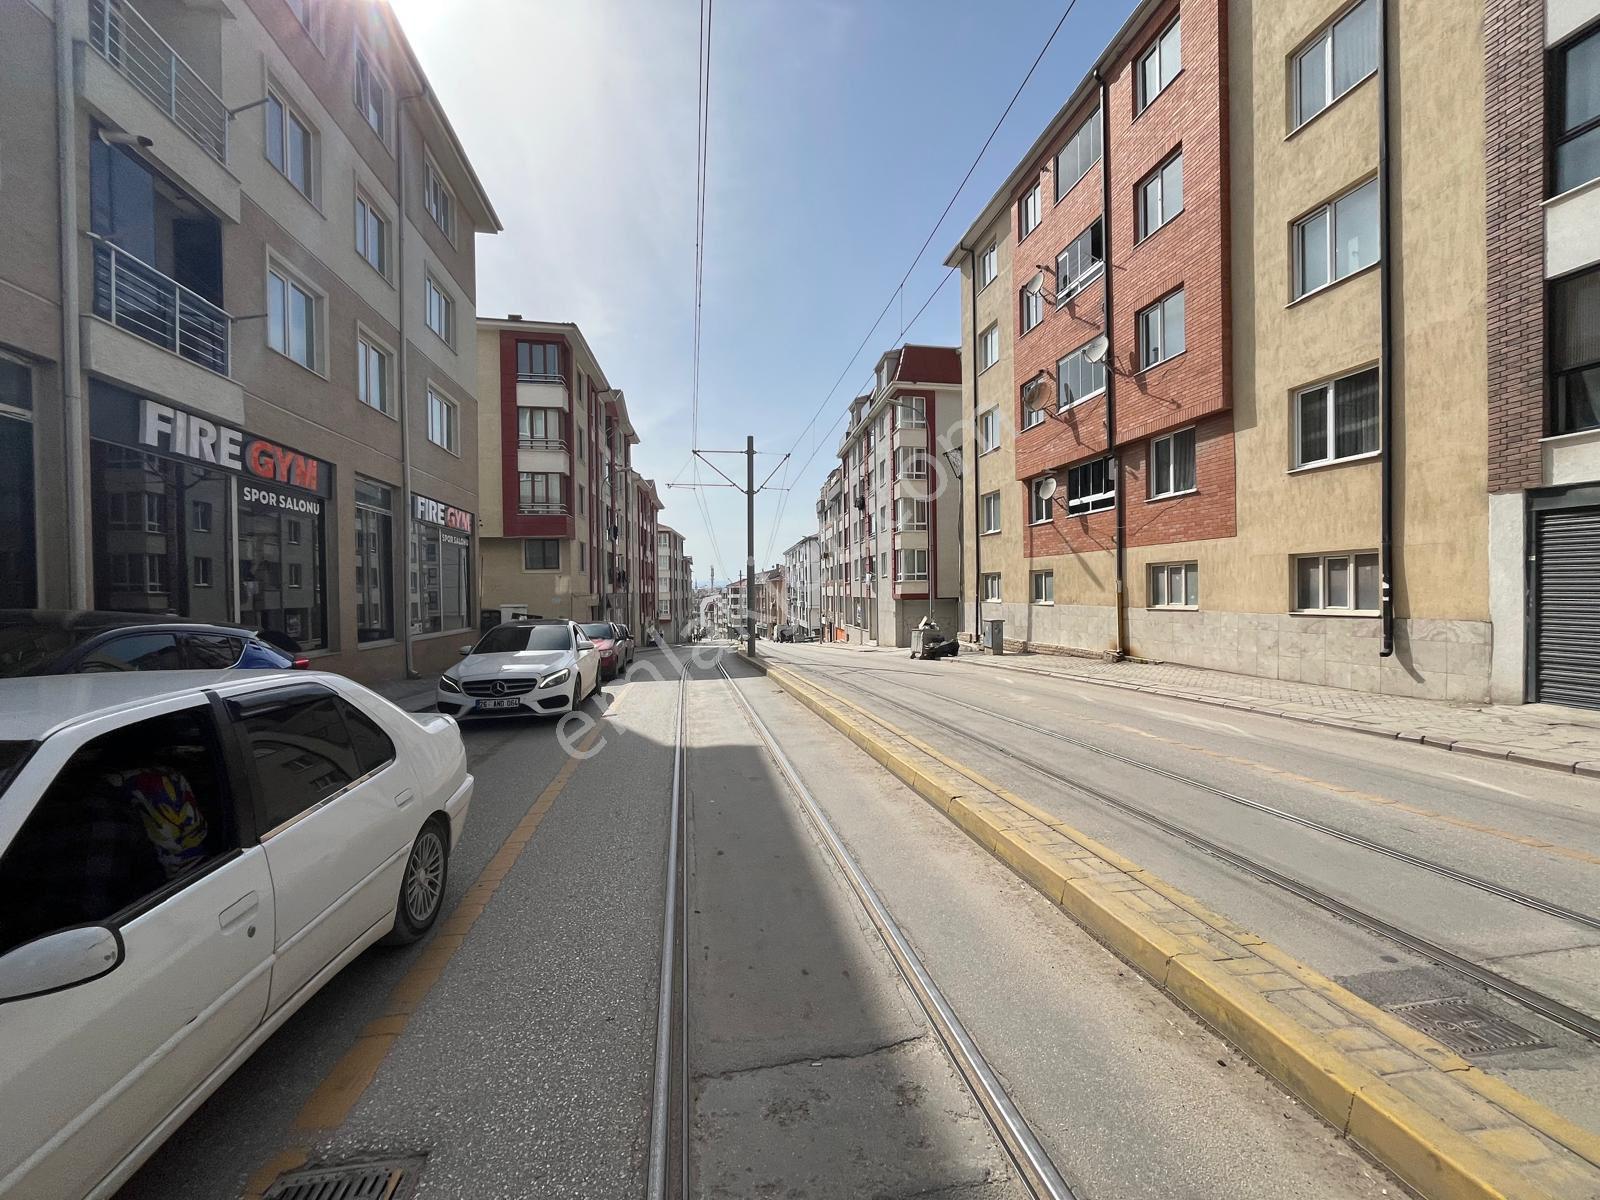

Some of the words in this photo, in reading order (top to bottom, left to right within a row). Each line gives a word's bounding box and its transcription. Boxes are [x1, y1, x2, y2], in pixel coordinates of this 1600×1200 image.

[139, 400, 243, 470] FIRE
[245, 440, 319, 491] GYM
[243, 486, 277, 507] SPOR
[279, 494, 320, 515] SALONU
[416, 496, 445, 525] FIRE
[447, 506, 471, 534] GYM
[442, 533, 453, 543] SPOR
